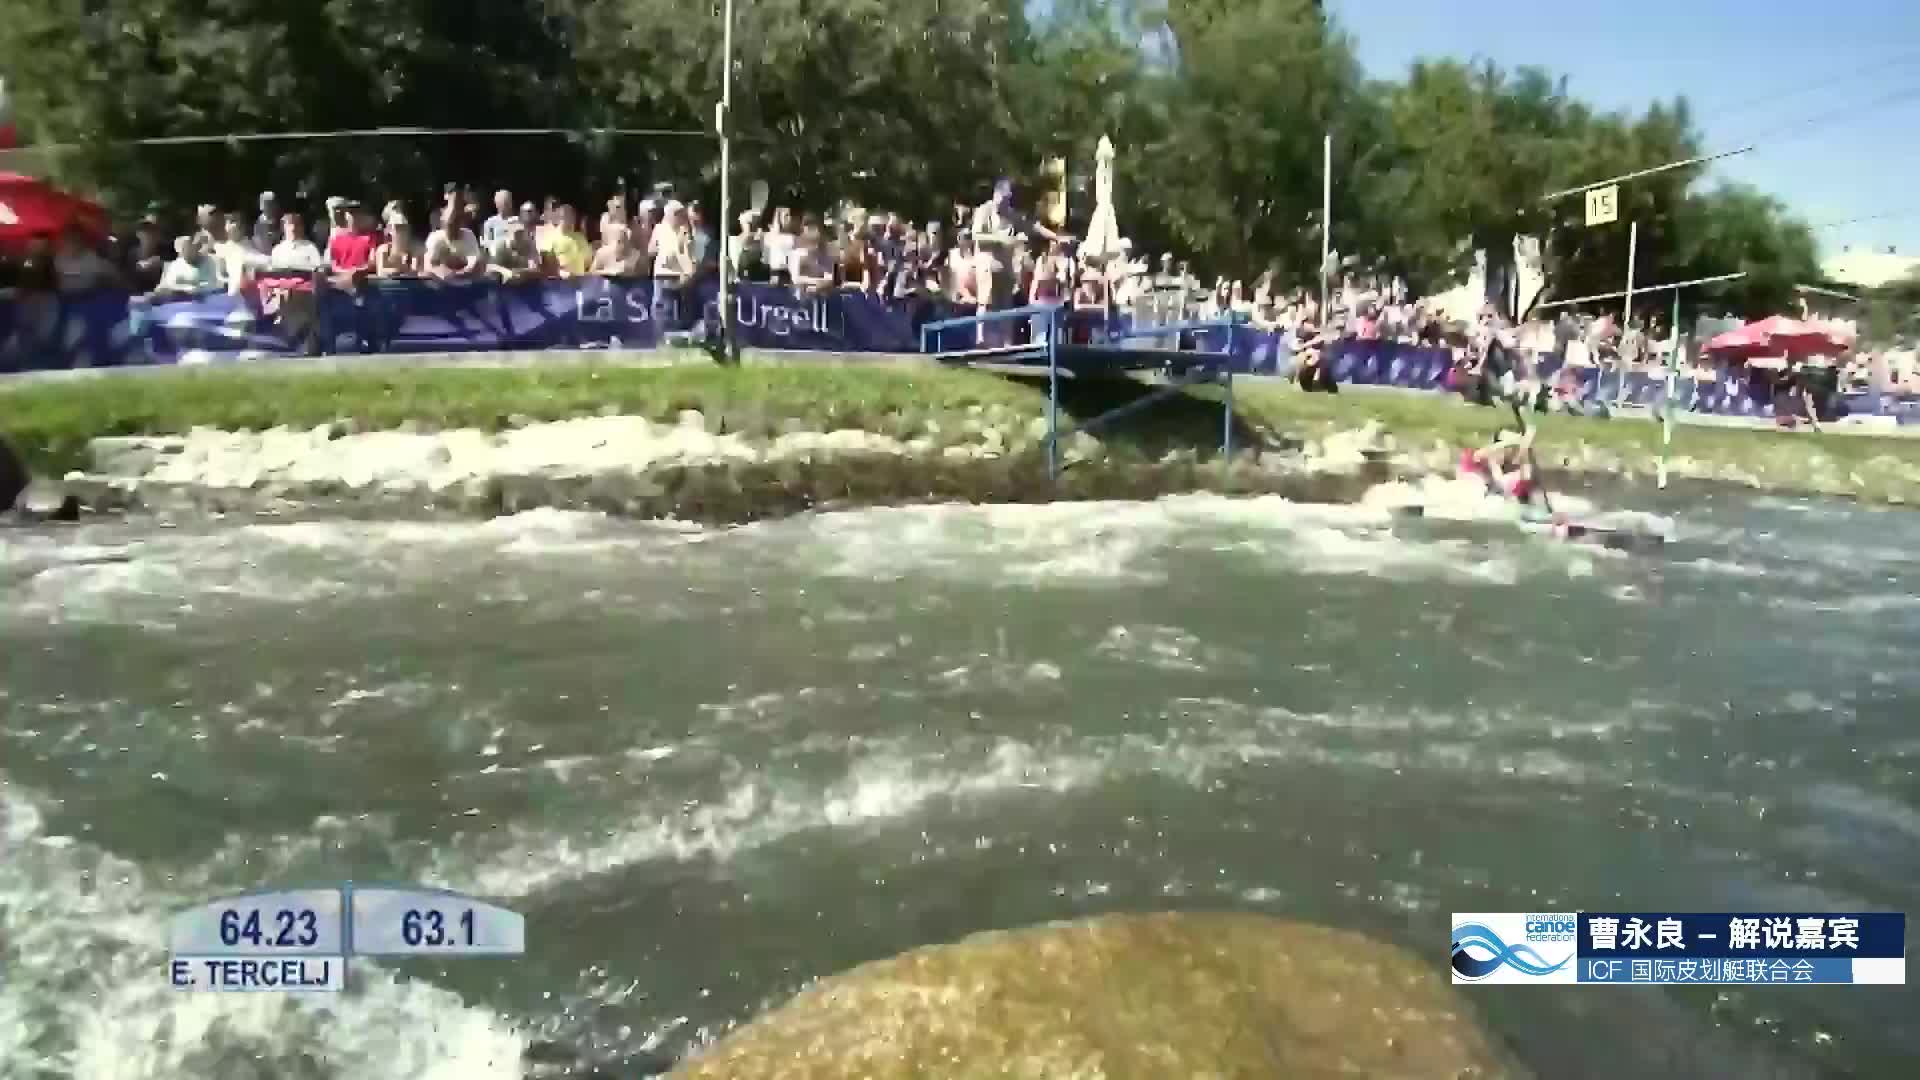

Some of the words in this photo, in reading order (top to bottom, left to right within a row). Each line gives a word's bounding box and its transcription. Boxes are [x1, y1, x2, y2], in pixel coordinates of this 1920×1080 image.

[1592, 195, 1614, 217] 15
[576, 288, 612, 321] La
[736, 294, 828, 336] Urgell
